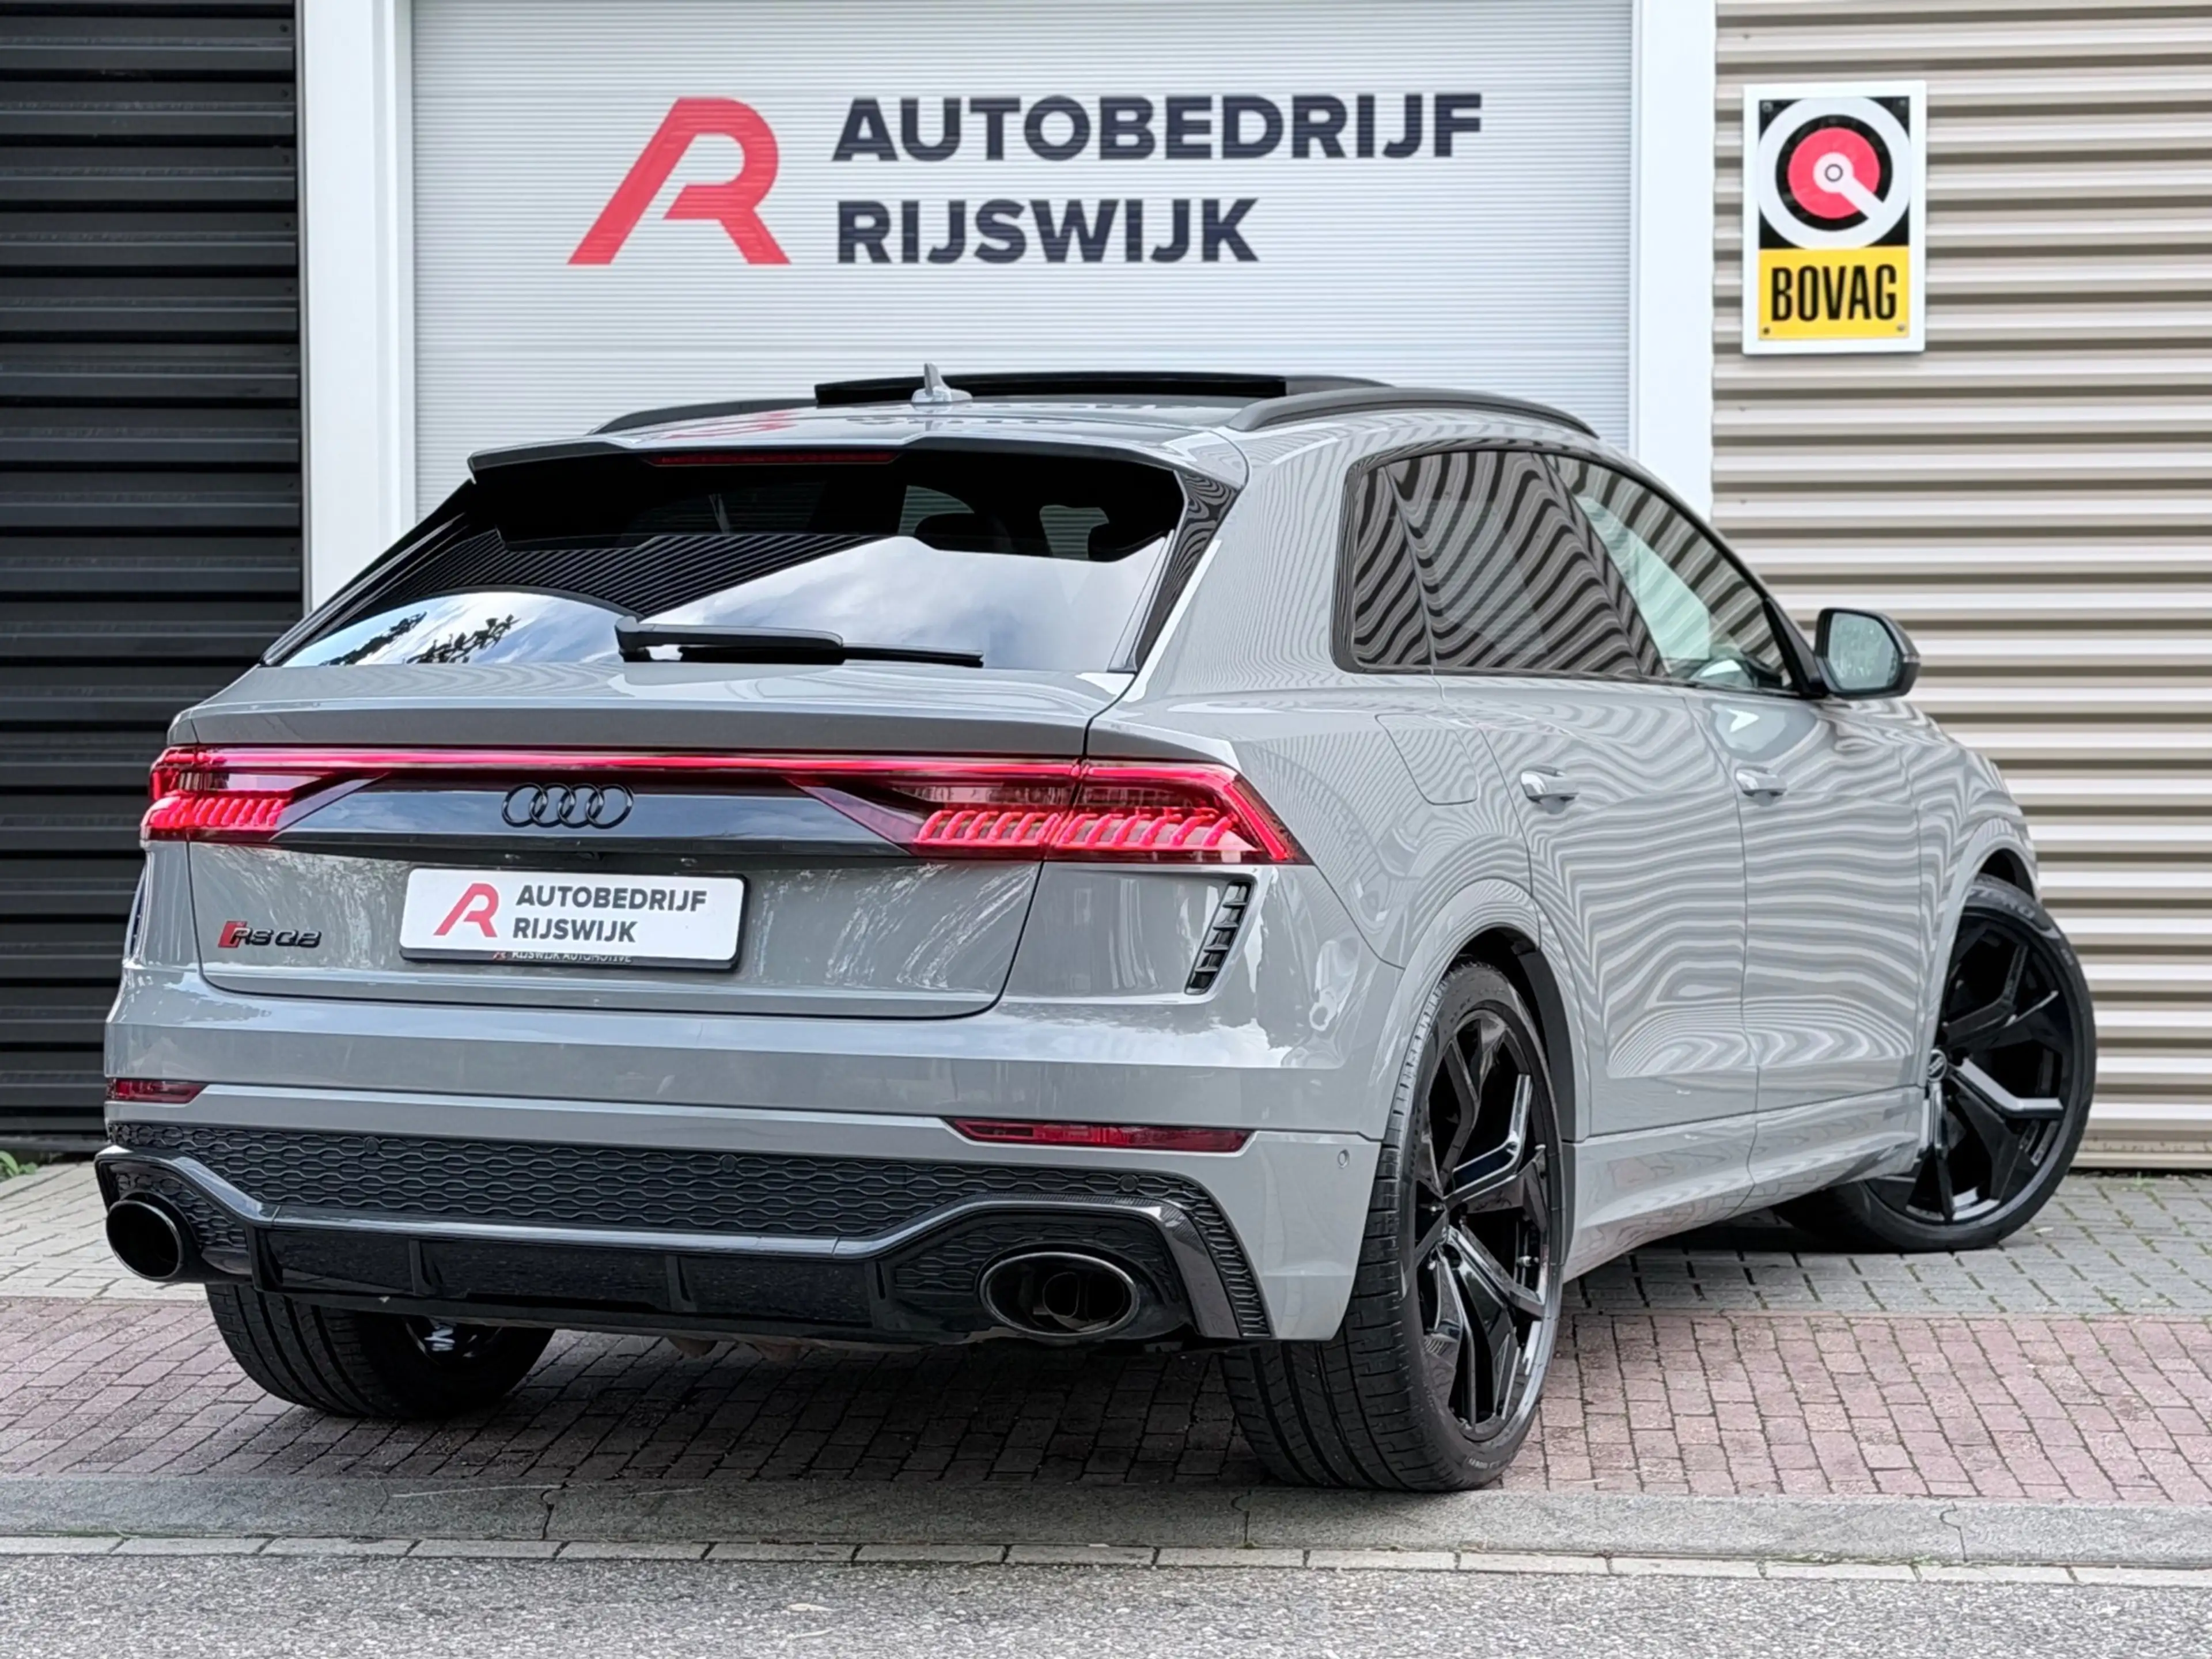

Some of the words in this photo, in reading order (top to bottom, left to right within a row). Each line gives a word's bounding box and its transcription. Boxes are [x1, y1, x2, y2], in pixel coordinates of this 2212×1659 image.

[833, 93, 1481, 161] AUTOBEDRIJF
[838, 198, 1257, 264] RIJSWIJK
[1771, 263, 1897, 322] BOVAG
[516, 884, 707, 912] AUTOBEDRIJF
[513, 917, 637, 943] RIJSWIJK
